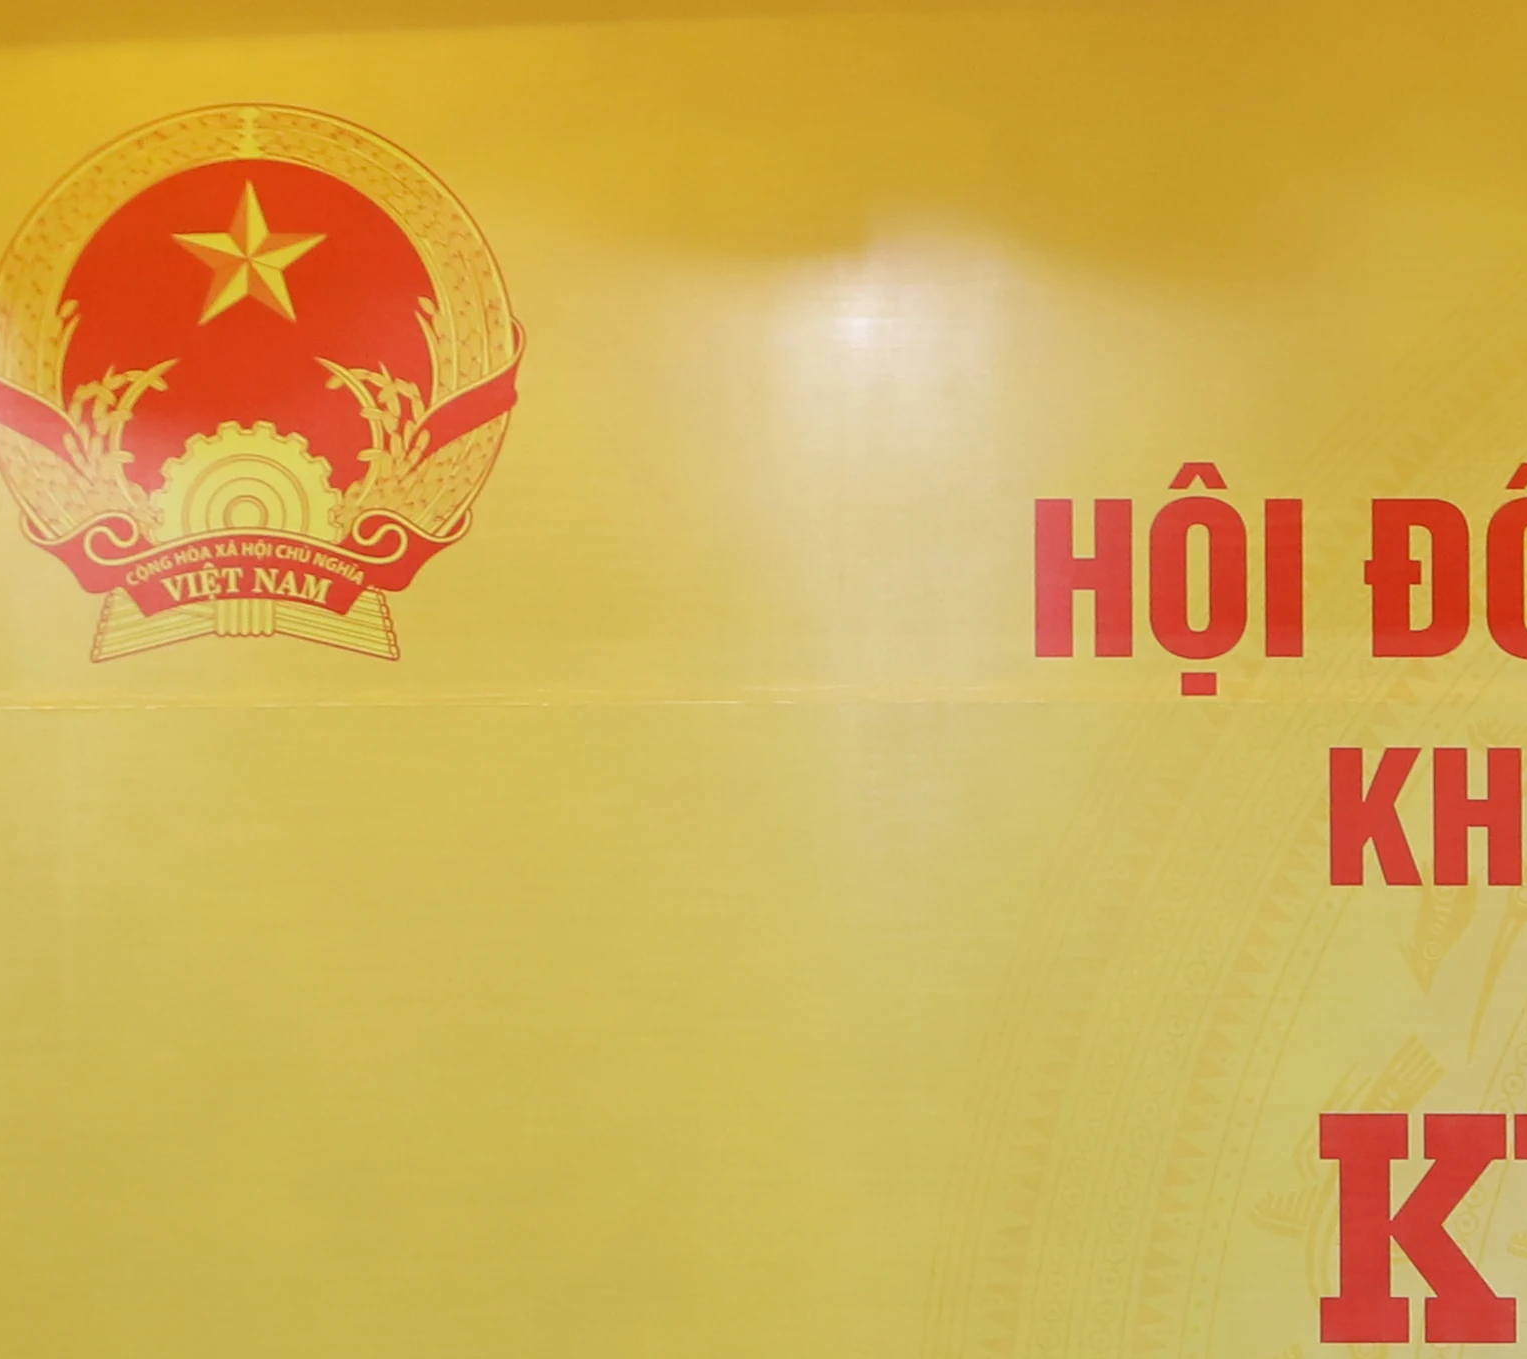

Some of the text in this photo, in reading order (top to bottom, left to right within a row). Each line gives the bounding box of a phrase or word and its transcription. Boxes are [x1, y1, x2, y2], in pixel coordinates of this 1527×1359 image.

[175, 545, 214, 566] HÒA
[241, 539, 273, 560] HỘI
[161, 561, 333, 605] VIỆT NAM
[1035, 461, 1305, 697] HỘI
